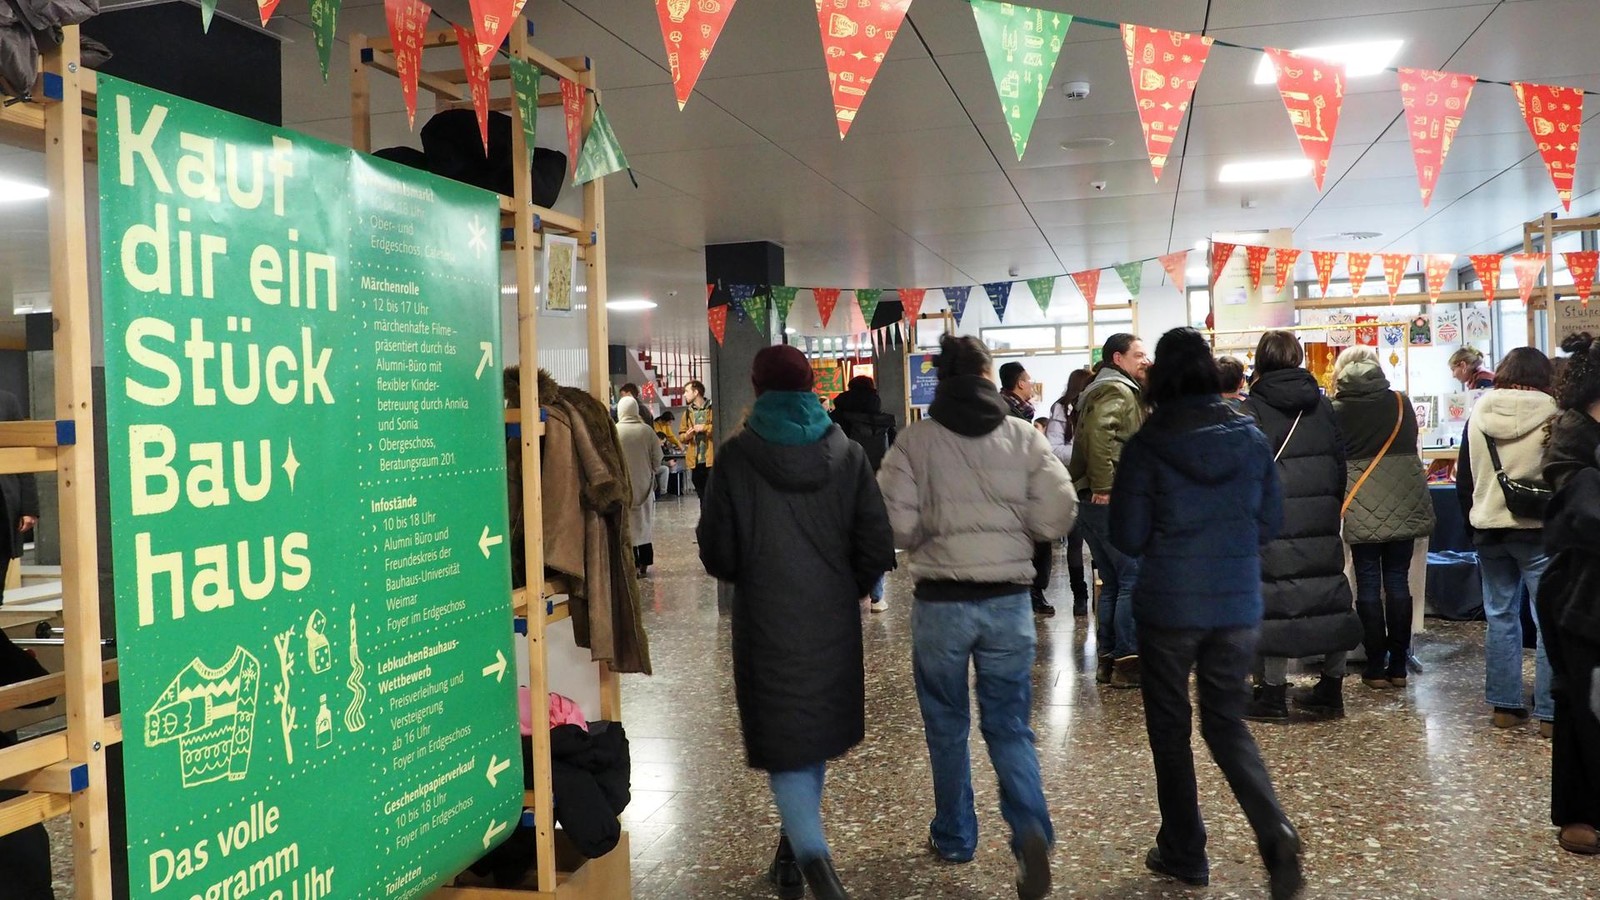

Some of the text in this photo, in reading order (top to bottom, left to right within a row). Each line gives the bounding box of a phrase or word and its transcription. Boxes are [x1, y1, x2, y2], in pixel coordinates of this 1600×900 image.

[116, 94, 293, 217] Kauf
[370, 214, 414, 235] Ober- und
[121, 203, 337, 312] dir ein
[361, 276, 420, 295] Märchenrolle
[373, 298, 429, 316] 12 bis 17 Uhr
[373, 319, 429, 334] märchenhafte
[125, 316, 335, 407] Stück
[375, 339, 457, 355] präsentiert durch das
[376, 358, 442, 373] Alumni-Büro mit
[377, 377, 439, 392] flexibler Kinder-
[377, 397, 469, 414] betreuung durch Annika
[378, 417, 394, 431] und
[379, 436, 436, 454] Obergeschoss,
[128, 424, 272, 516] Bau
[380, 456, 439, 472] Beratungsraum
[371, 494, 418, 513] Infostände
[383, 511, 437, 531] 10 bis 18 Uhr
[383, 527, 449, 552] Alumni Büro und
[385, 547, 452, 571] Freundeskreis der
[135, 532, 311, 627] haus
[386, 562, 461, 592] Bauhaus-Universität
[386, 594, 418, 612] Weimar
[387, 599, 466, 633] Foyer im Erdgeschoss
[378, 639, 460, 675] LebkuchenBauhaus-
[378, 664, 432, 695] Wettbewerb
[389, 670, 464, 711] Preisverleihung und
[390, 700, 444, 730] Versteigerung
[392, 724, 431, 751] ab 16 Uhr
[393, 725, 472, 771] Foyer im Erdgeschoss
[384, 754, 475, 816] Geschenkpapierverkauf
[395, 792, 447, 829] 10 bis 18 Uhr
[396, 796, 474, 850] Foyer im Erdgeschoss
[149, 800, 280, 894] Das volle
[292, 865, 335, 900] Uhr
[386, 865, 422, 896] Toiletten
